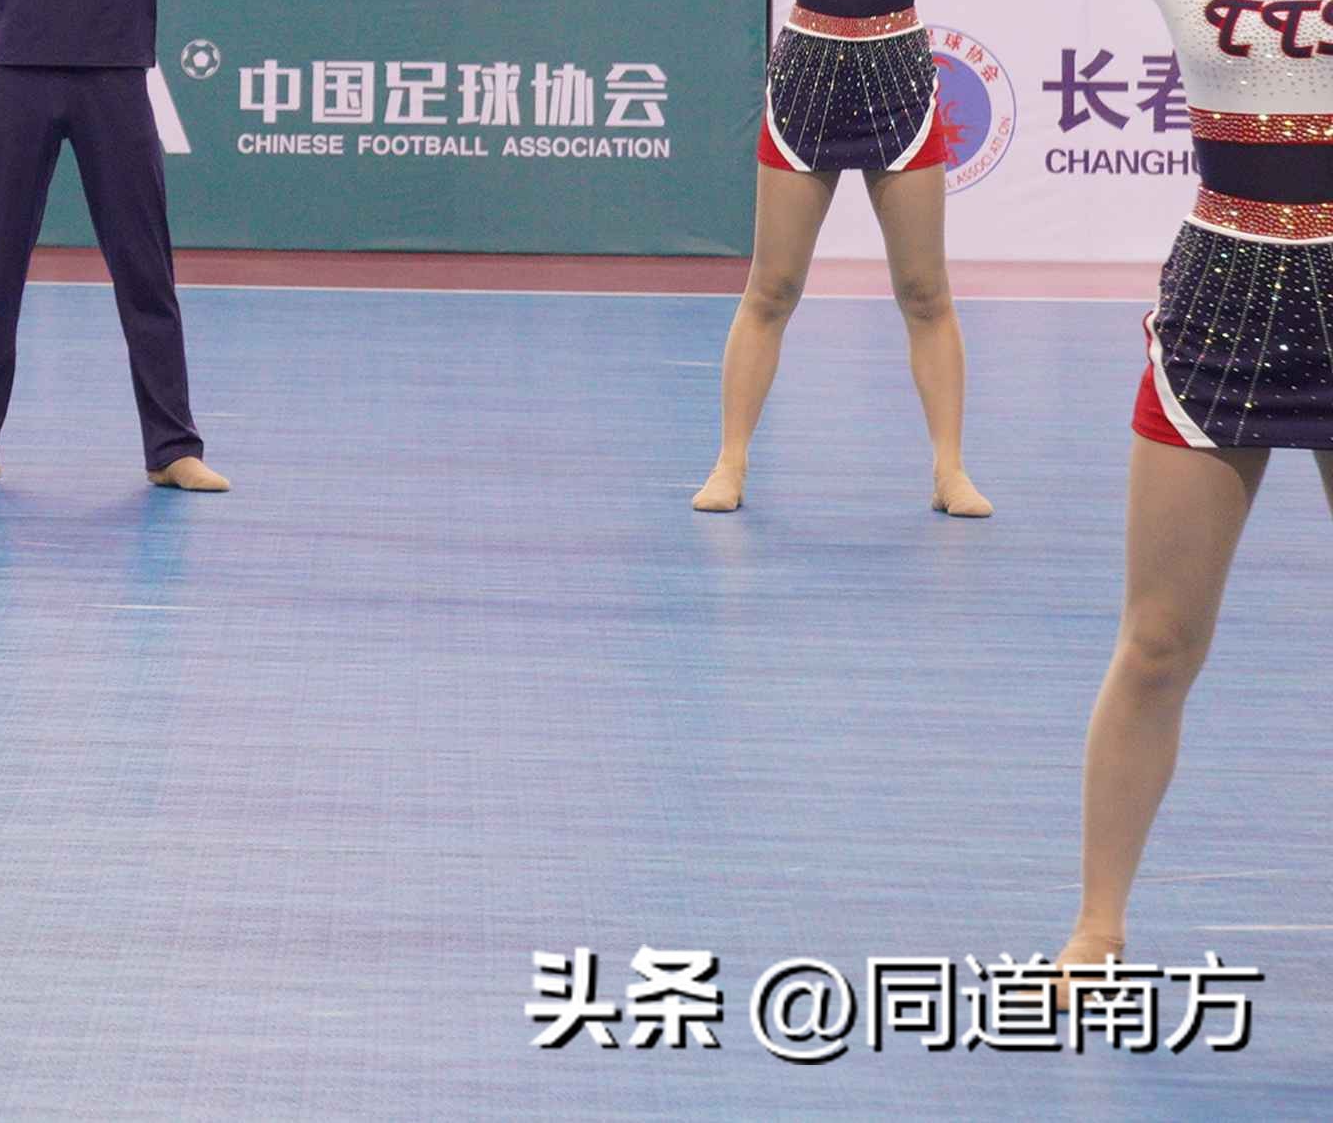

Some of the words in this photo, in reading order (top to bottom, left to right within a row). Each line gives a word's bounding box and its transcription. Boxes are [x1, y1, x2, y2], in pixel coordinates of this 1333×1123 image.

[237, 60, 670, 127] 中国足球协会
[237, 133, 345, 156] CHINESE
[357, 134, 489, 157] FOOTBALL
[501, 135, 671, 159] ASSOCIATION
